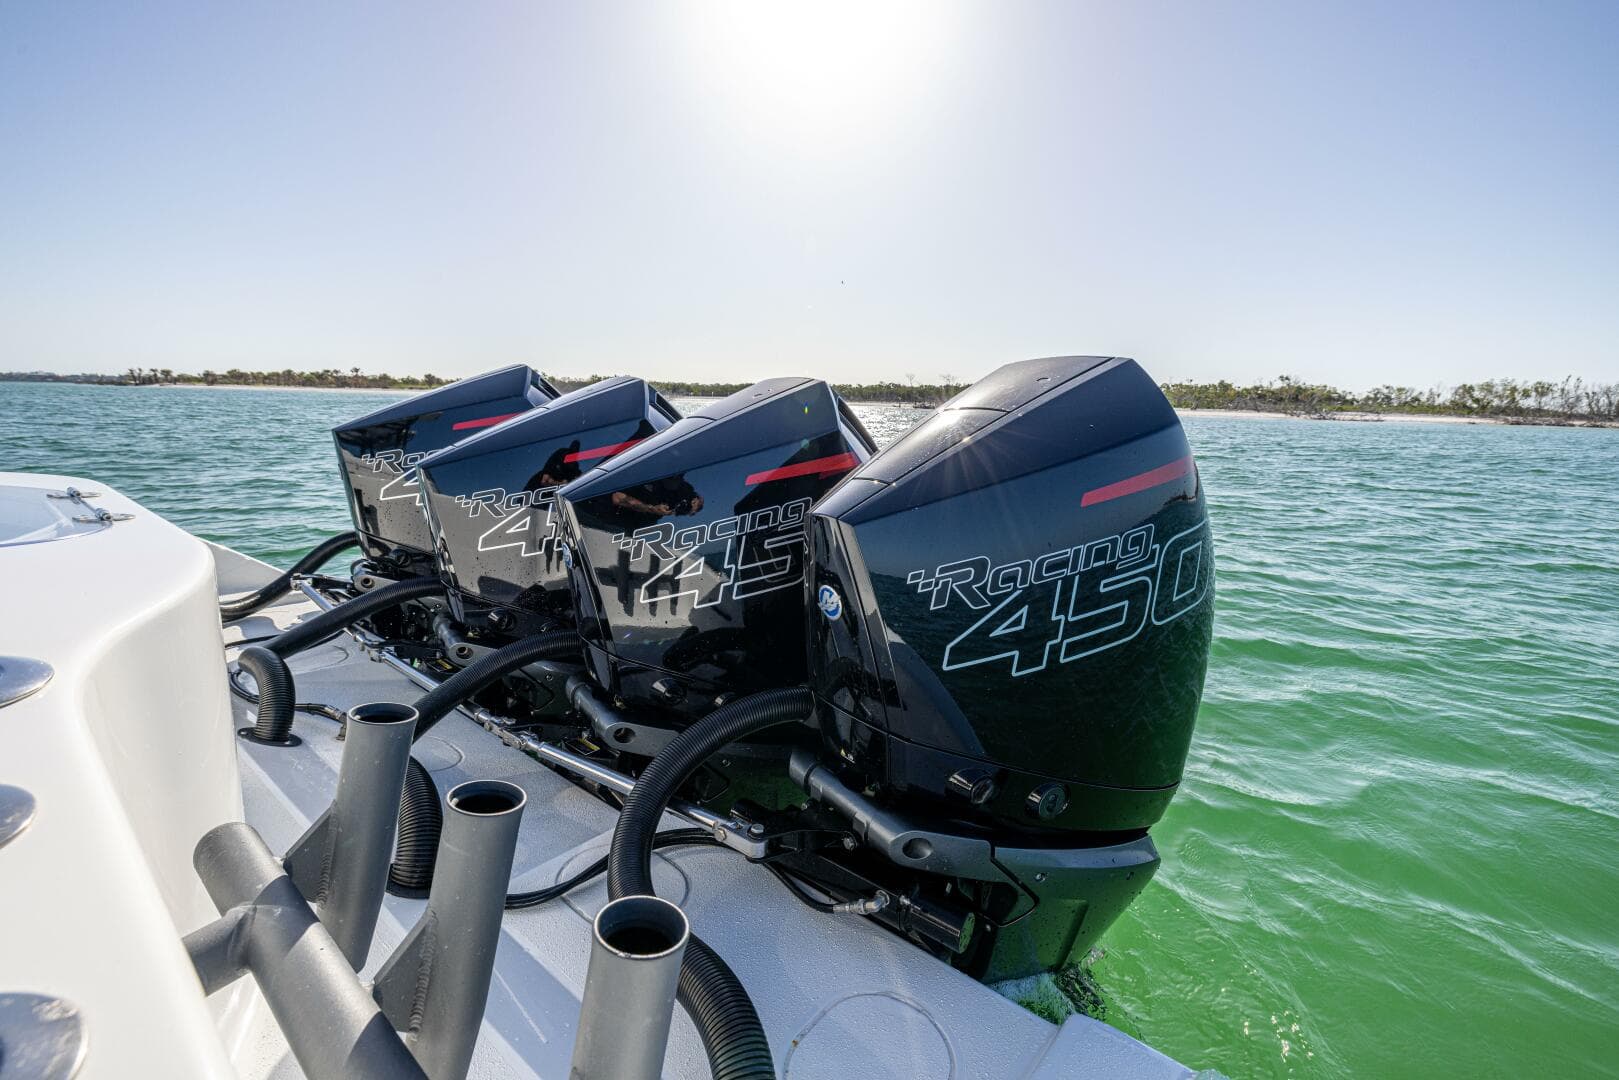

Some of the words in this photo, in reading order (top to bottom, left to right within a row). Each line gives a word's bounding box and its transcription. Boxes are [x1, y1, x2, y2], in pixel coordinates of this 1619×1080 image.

[373, 449, 442, 473] Ra
[470, 485, 568, 518] Rac
[478, 503, 563, 557] 4
[630, 497, 812, 561] Racing
[930, 524, 1155, 610] Racing
[943, 519, 1211, 677] 450
